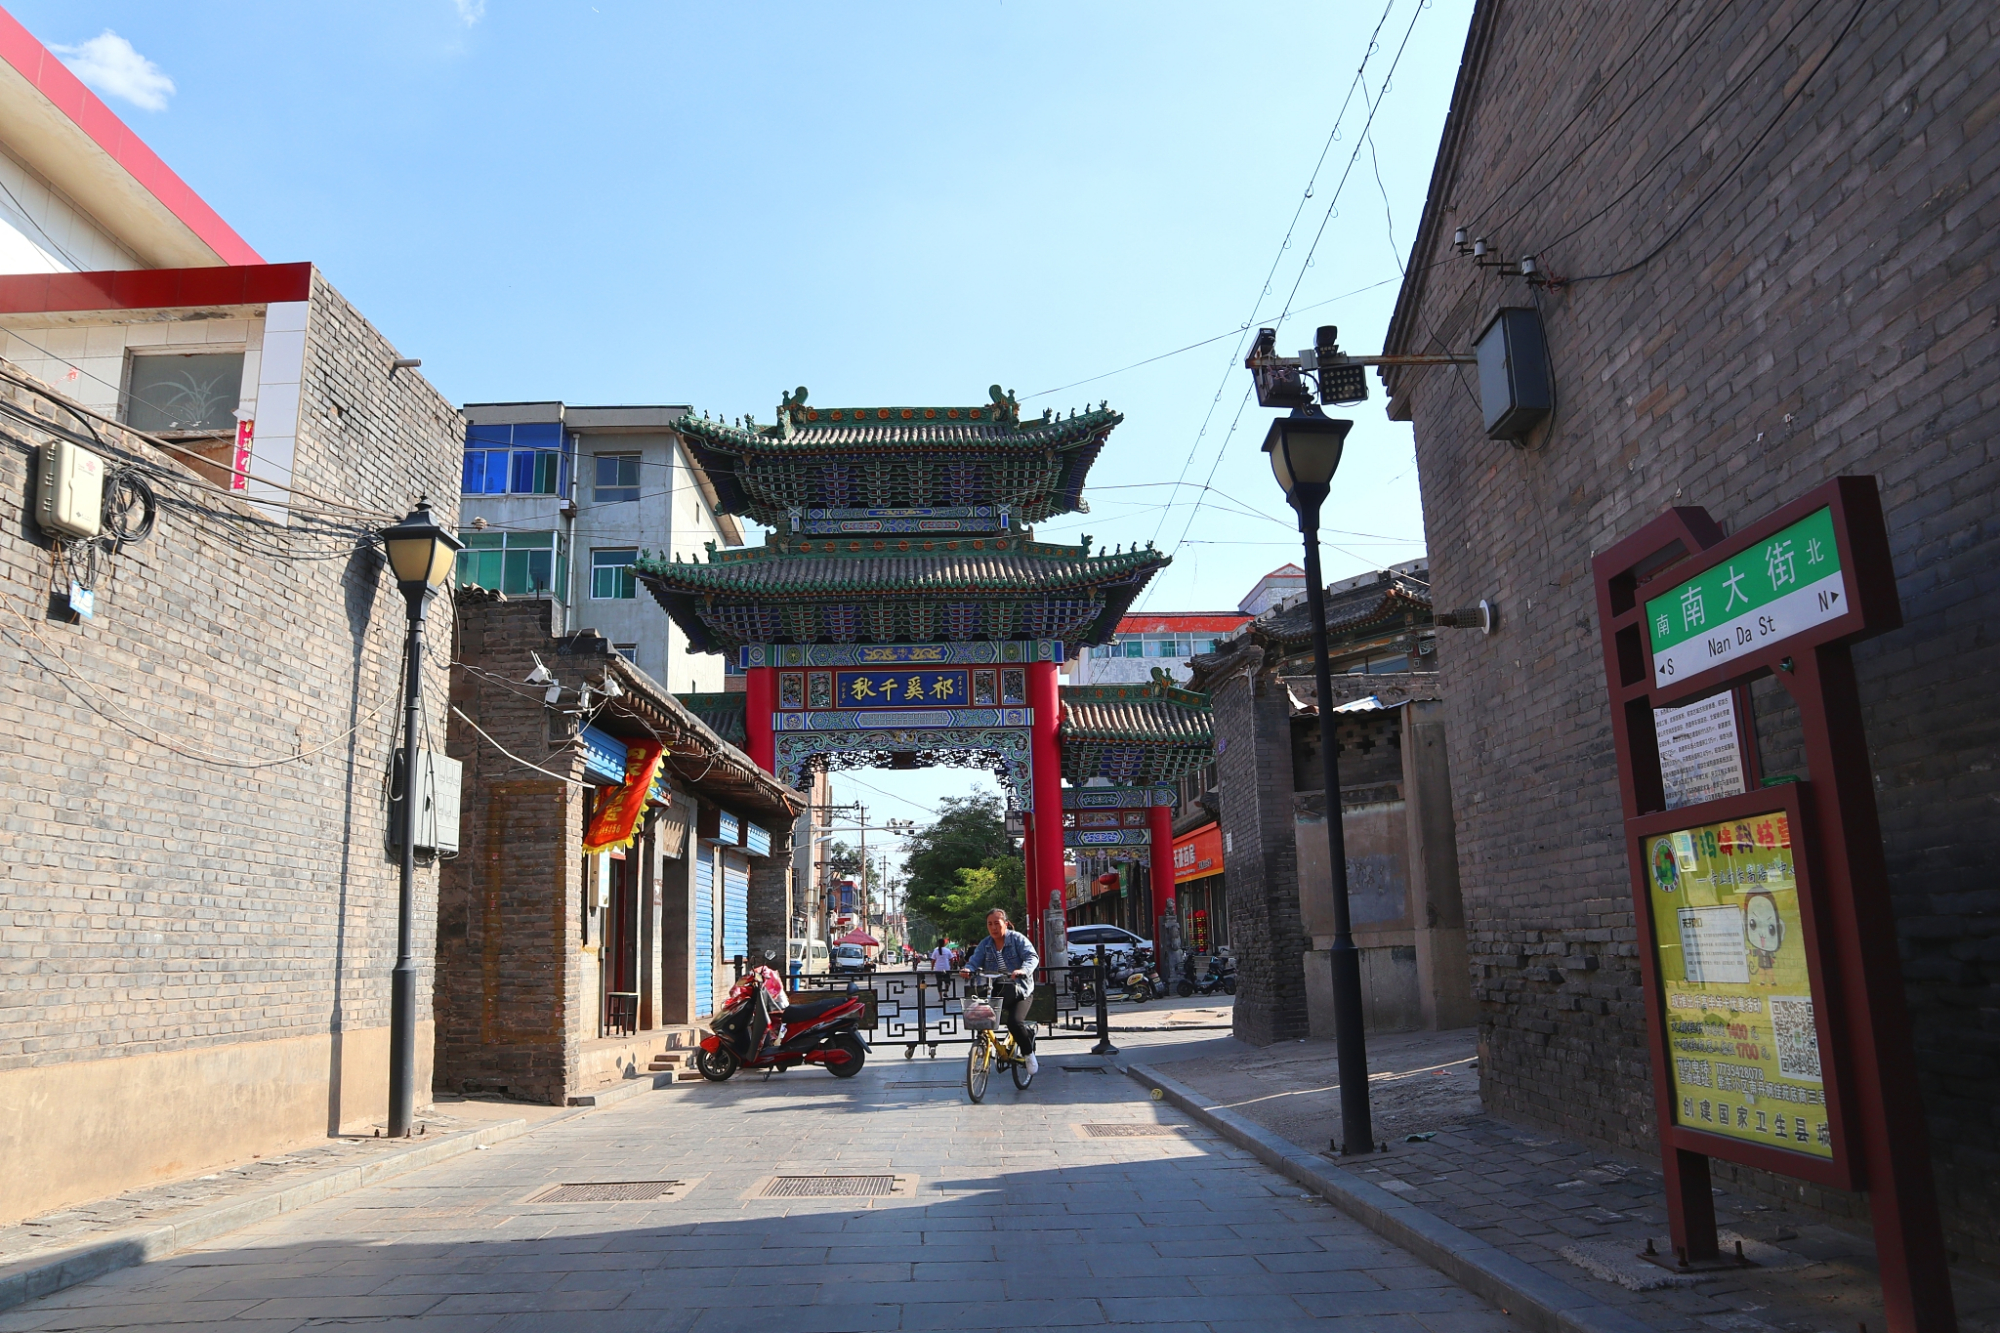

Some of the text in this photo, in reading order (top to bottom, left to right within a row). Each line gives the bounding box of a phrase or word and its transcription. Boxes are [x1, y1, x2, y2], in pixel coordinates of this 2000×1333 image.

[1656, 537, 1825, 638] 南 南大街 北
[1817, 590, 1830, 613] N
[1707, 615, 1777, 658] Nan Da St
[1666, 658, 1675, 676] S
[1735, 1042, 1760, 1060] 1700
[1714, 1061, 1765, 1081] 17735428078
[1682, 1096, 1832, 1149] 创建国家卫生县城
